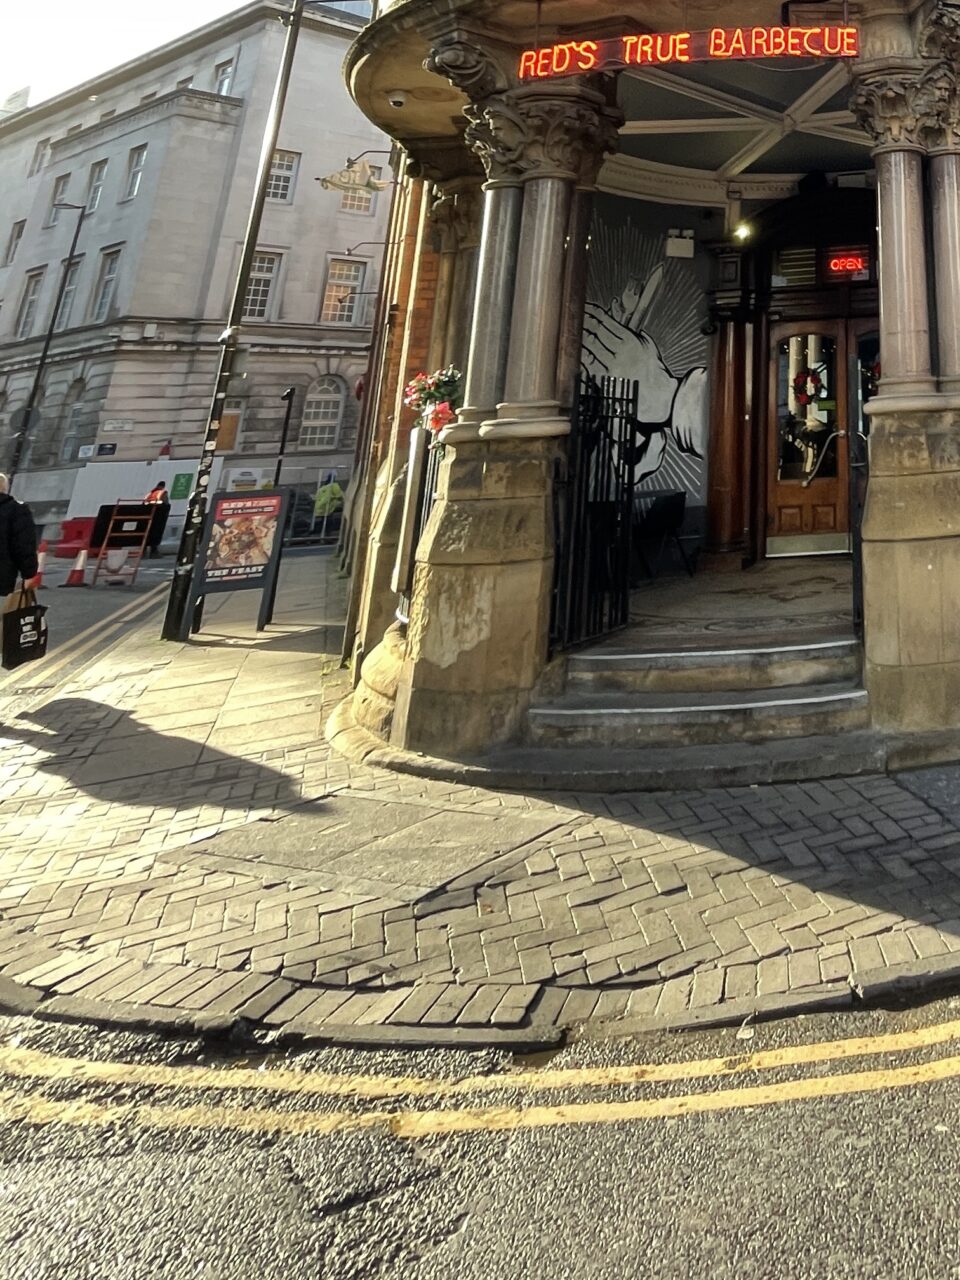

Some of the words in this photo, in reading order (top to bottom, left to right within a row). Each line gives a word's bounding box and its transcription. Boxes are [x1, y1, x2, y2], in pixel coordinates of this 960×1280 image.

[518, 40, 598, 79] RED'S
[622, 32, 691, 64] TRUE
[709, 27, 858, 57] BARBECUE
[830, 258, 863, 270] OPEN
